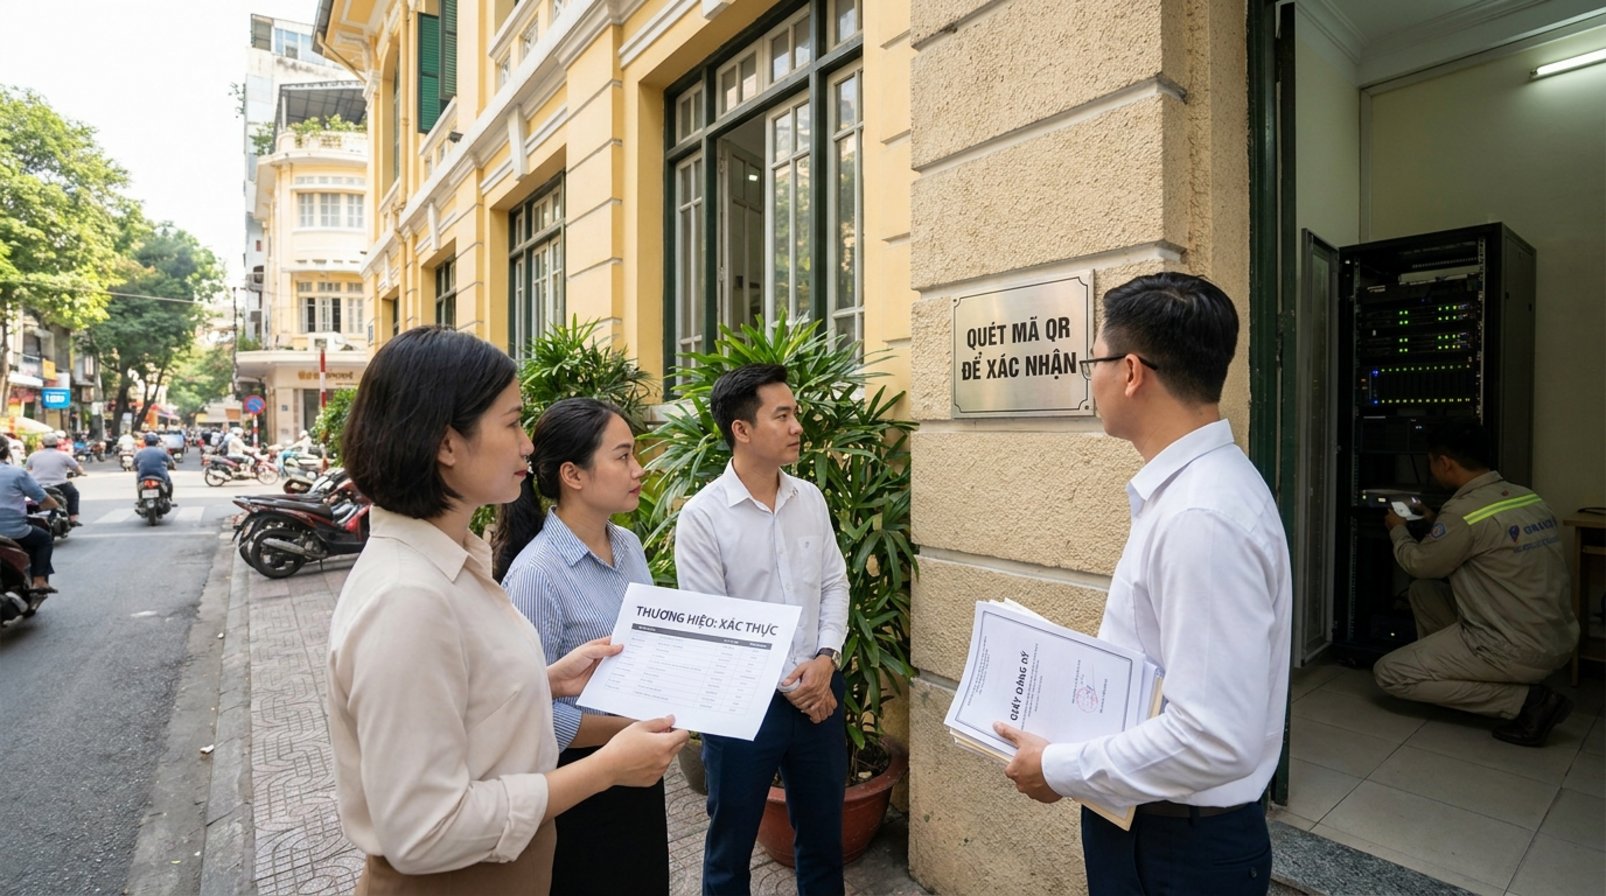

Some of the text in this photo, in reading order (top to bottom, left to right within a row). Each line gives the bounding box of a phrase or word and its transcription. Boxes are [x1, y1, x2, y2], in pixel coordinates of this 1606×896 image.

[967, 316, 1071, 351] QUÉT MÃ QR
[962, 348, 1077, 380] ĐỂ XÁC NHẬN
[719, 617, 743, 631] XÁC
[745, 622, 779, 637] THỰC
